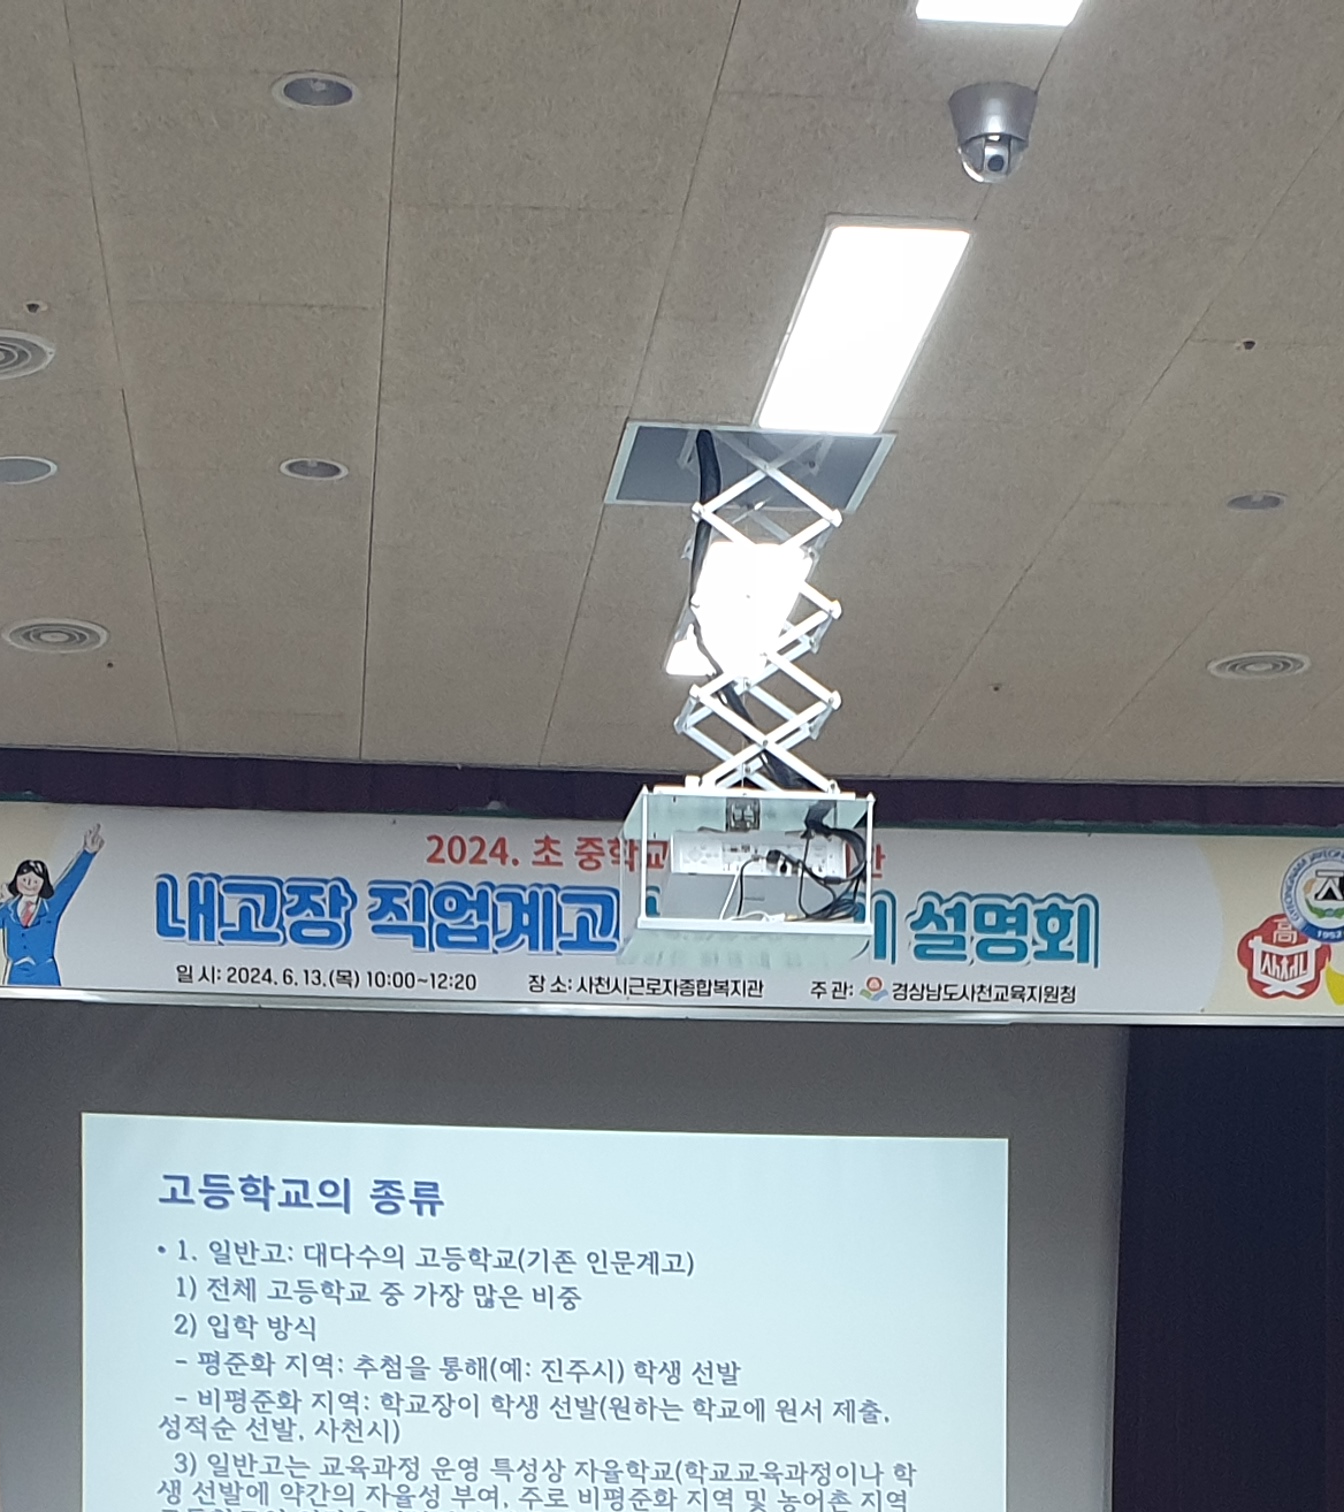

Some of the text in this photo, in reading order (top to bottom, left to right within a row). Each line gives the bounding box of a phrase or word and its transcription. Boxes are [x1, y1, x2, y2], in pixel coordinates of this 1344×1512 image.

[426, 834, 520, 868] 2024.
[532, 836, 563, 869] 초
[155, 872, 622, 956] 내고장 직업계고
[907, 890, 1100, 968] 설명회
[176, 964, 194, 984] 일
[197, 965, 221, 985] 시:
[226, 966, 278, 986] 2024.
[282, 968, 298, 987] 6.
[367, 969, 478, 992] 10:00~12:20
[528, 974, 764, 999] 장 소: 사천시근로자종합복지관
[810, 981, 1076, 1005] 주 관: 경상남도사천교육지원청
[158, 1173, 445, 1218] 고등학교의 종류
[178, 1238, 695, 1278] 1. 일반고: 대다수의 고등학교(기존 인문계고)
[176, 1275, 583, 1312] 1) 전체 고등학교 중 가장 많은 비중
[174, 1312, 316, 1343] 2) 입학 방식
[197, 1349, 277, 1378] 평준화
[284, 1351, 344, 1380] 지역:
[352, 1353, 432, 1382] 추첨을
[438, 1356, 531, 1383] 통해(예:
[540, 1357, 625, 1385] 진주시)
[633, 1359, 681, 1386] 학생
[691, 1359, 742, 1387] 선발
[197, 1387, 303, 1416] 비평준화
[311, 1389, 370, 1417] 지역:
[379, 1390, 479, 1419] 학교장이
[490, 1393, 539, 1421] 학생
[549, 1394, 685, 1422] 선발(원하는
[692, 1396, 765, 1423] 학교에
[774, 1397, 822, 1424] 원서
[158, 1413, 237, 1442] 성적순
[314, 1417, 401, 1445] 사천시)
[173, 1451, 918, 1488] 3) 일반고는 교육과정 운영 특성상 자율학교(학교교육과정이나 학
[156, 1478, 182, 1506] 생
[192, 1479, 269, 1507] 선발에
[280, 1481, 355, 1508] 약간의
[365, 1482, 440, 1510] 자율성
[517, 1486, 570, 1511] 주로
[577, 1485, 679, 1512] 비평준화
